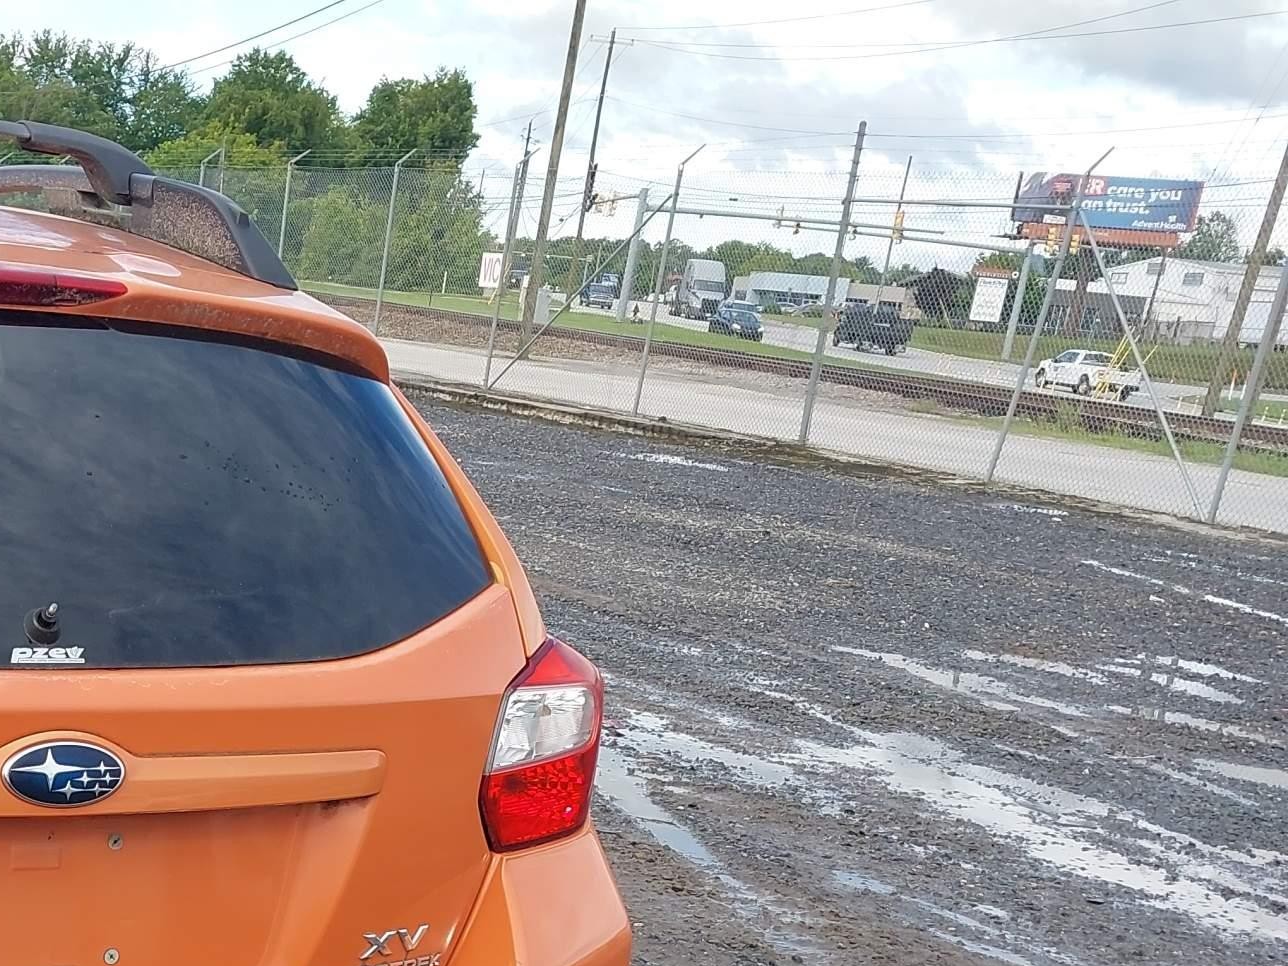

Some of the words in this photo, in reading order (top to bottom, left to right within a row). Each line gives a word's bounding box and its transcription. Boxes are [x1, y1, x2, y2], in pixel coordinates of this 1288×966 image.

[1107, 185, 1145, 198] care
[1148, 188, 1183, 203] you
[1105, 198, 1151, 214] trust.
[483, 257, 501, 283] VIC
[359, 923, 429, 960] XV
